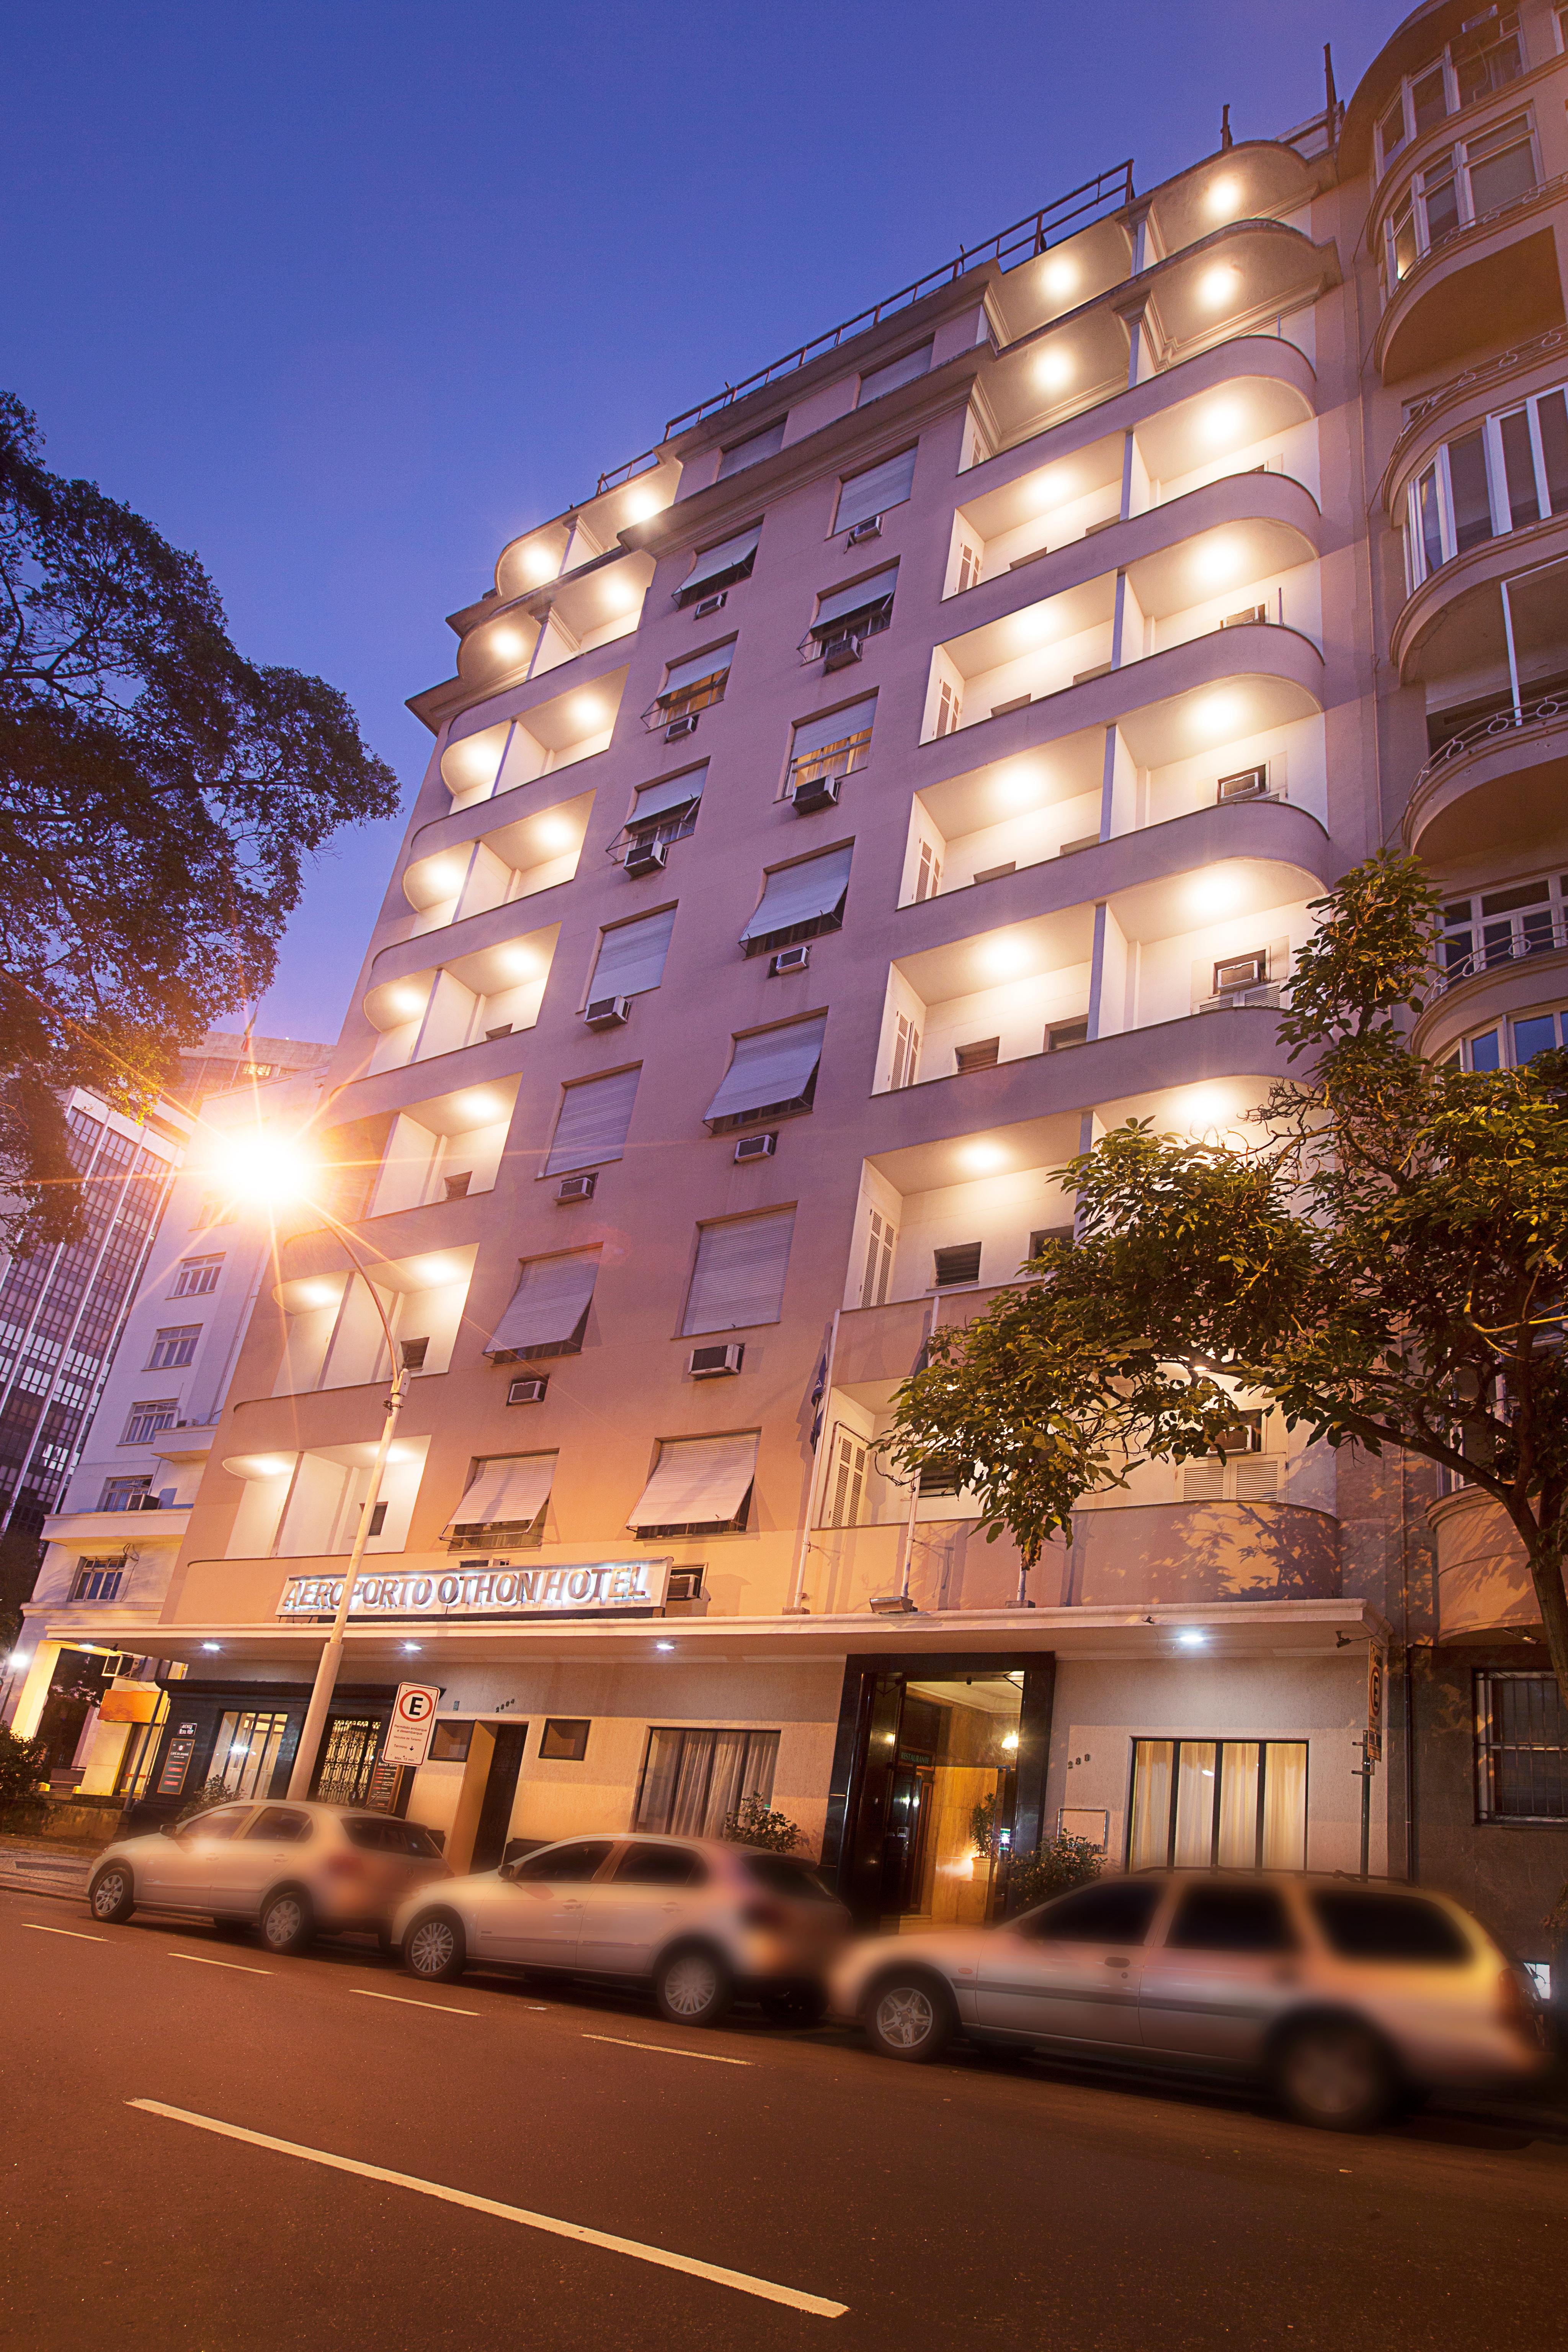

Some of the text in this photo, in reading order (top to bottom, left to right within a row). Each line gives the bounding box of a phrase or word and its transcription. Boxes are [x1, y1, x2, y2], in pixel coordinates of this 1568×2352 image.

[282, 1566, 646, 1607] AEROPORTO OTHON HOTEL
[409, 1697, 423, 1716] E
[900, 1752, 929, 1764] RESTAURANTE
[1068, 1754, 1090, 1769] 280
